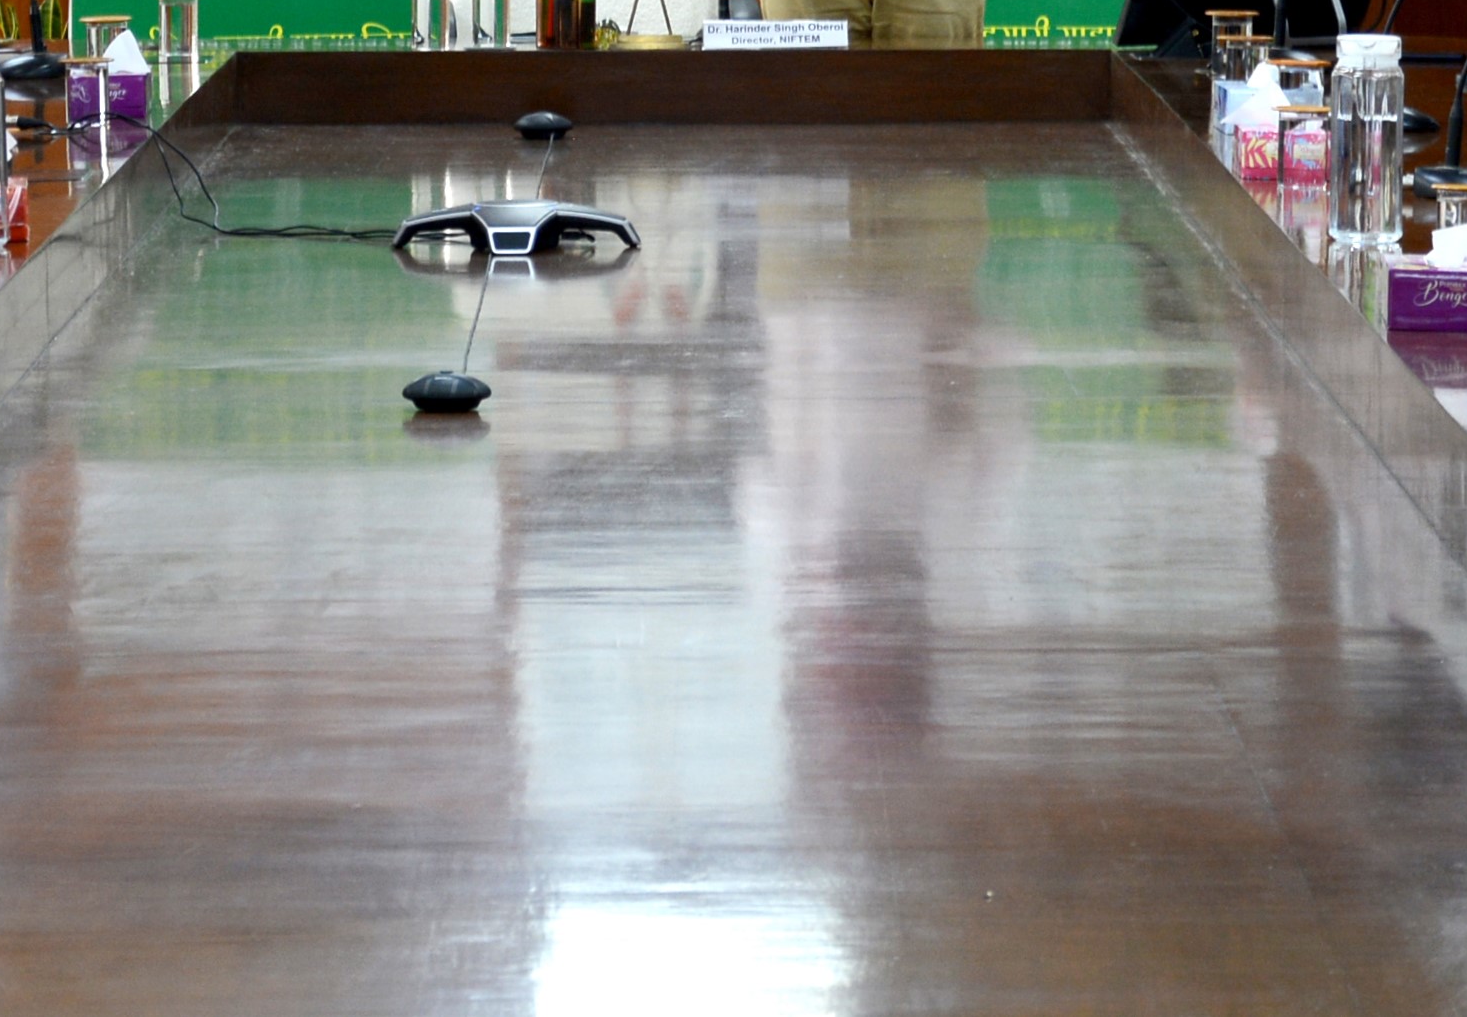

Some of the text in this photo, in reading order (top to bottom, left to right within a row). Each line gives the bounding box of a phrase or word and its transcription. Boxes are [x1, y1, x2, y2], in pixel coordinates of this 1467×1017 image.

[707, 25, 722, 34] Dr.
[726, 24, 771, 34] Harinder
[774, 23, 805, 33] Singh
[779, 35, 820, 43] NIFTEM
